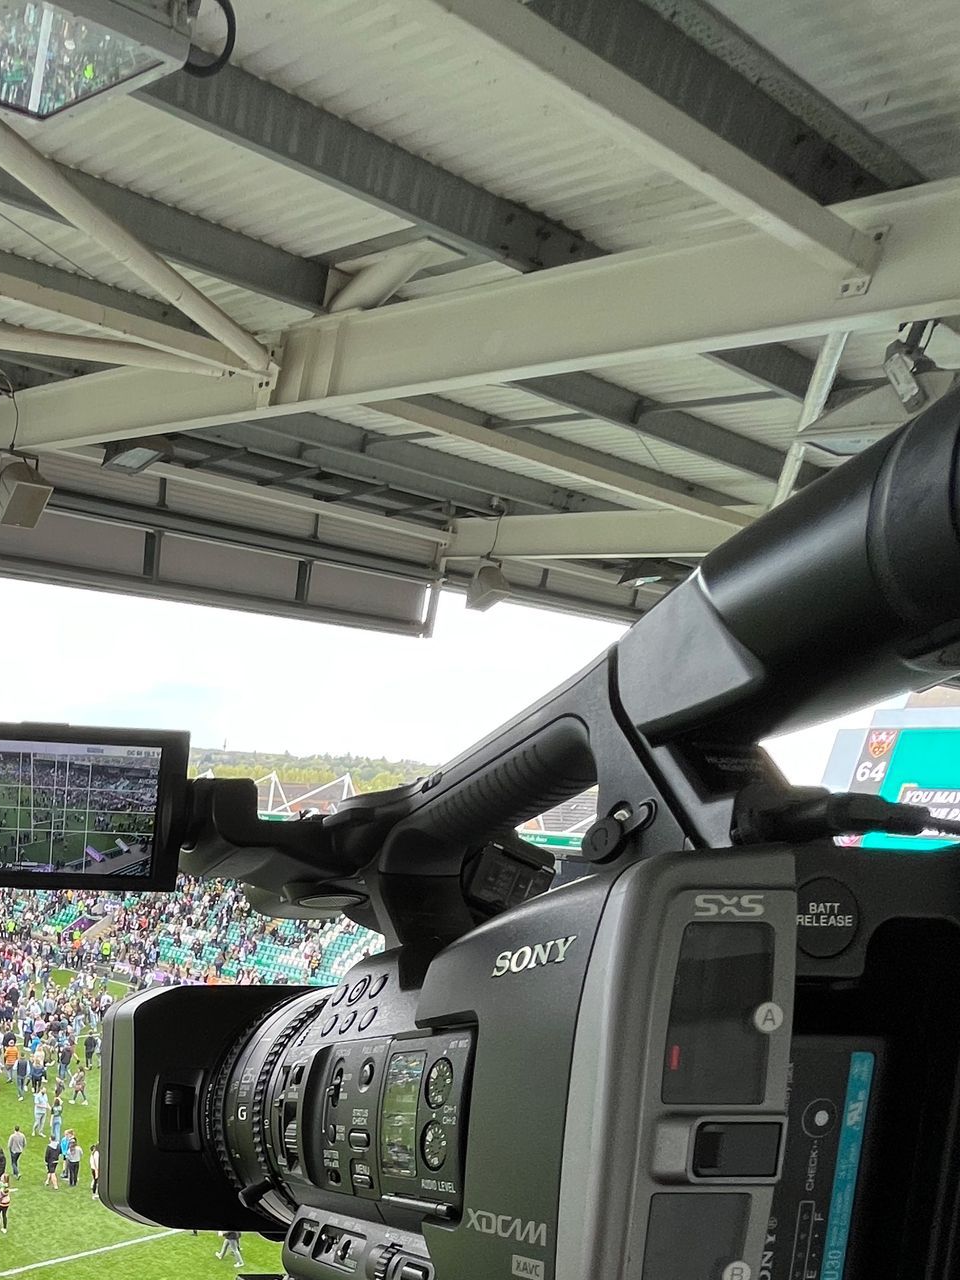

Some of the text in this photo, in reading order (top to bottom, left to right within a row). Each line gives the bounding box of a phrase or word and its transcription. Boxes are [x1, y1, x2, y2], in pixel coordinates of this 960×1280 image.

[856, 761, 887, 782] 64
[903, 790, 932, 803] YOU
[809, 902, 841, 914] BATT
[796, 915, 853, 926] RELEASE
[491, 935, 577, 978] SONY
[762, 1009, 776, 1026] A
[238, 1106, 247, 1120] G
[355, 1163, 370, 1175] MENU
[805, 1148, 819, 1191] CHECK
[438, 1181, 456, 1193] LEVEL
[466, 1208, 547, 1247] XDCAM
[806, 1270, 817, 1279] E
